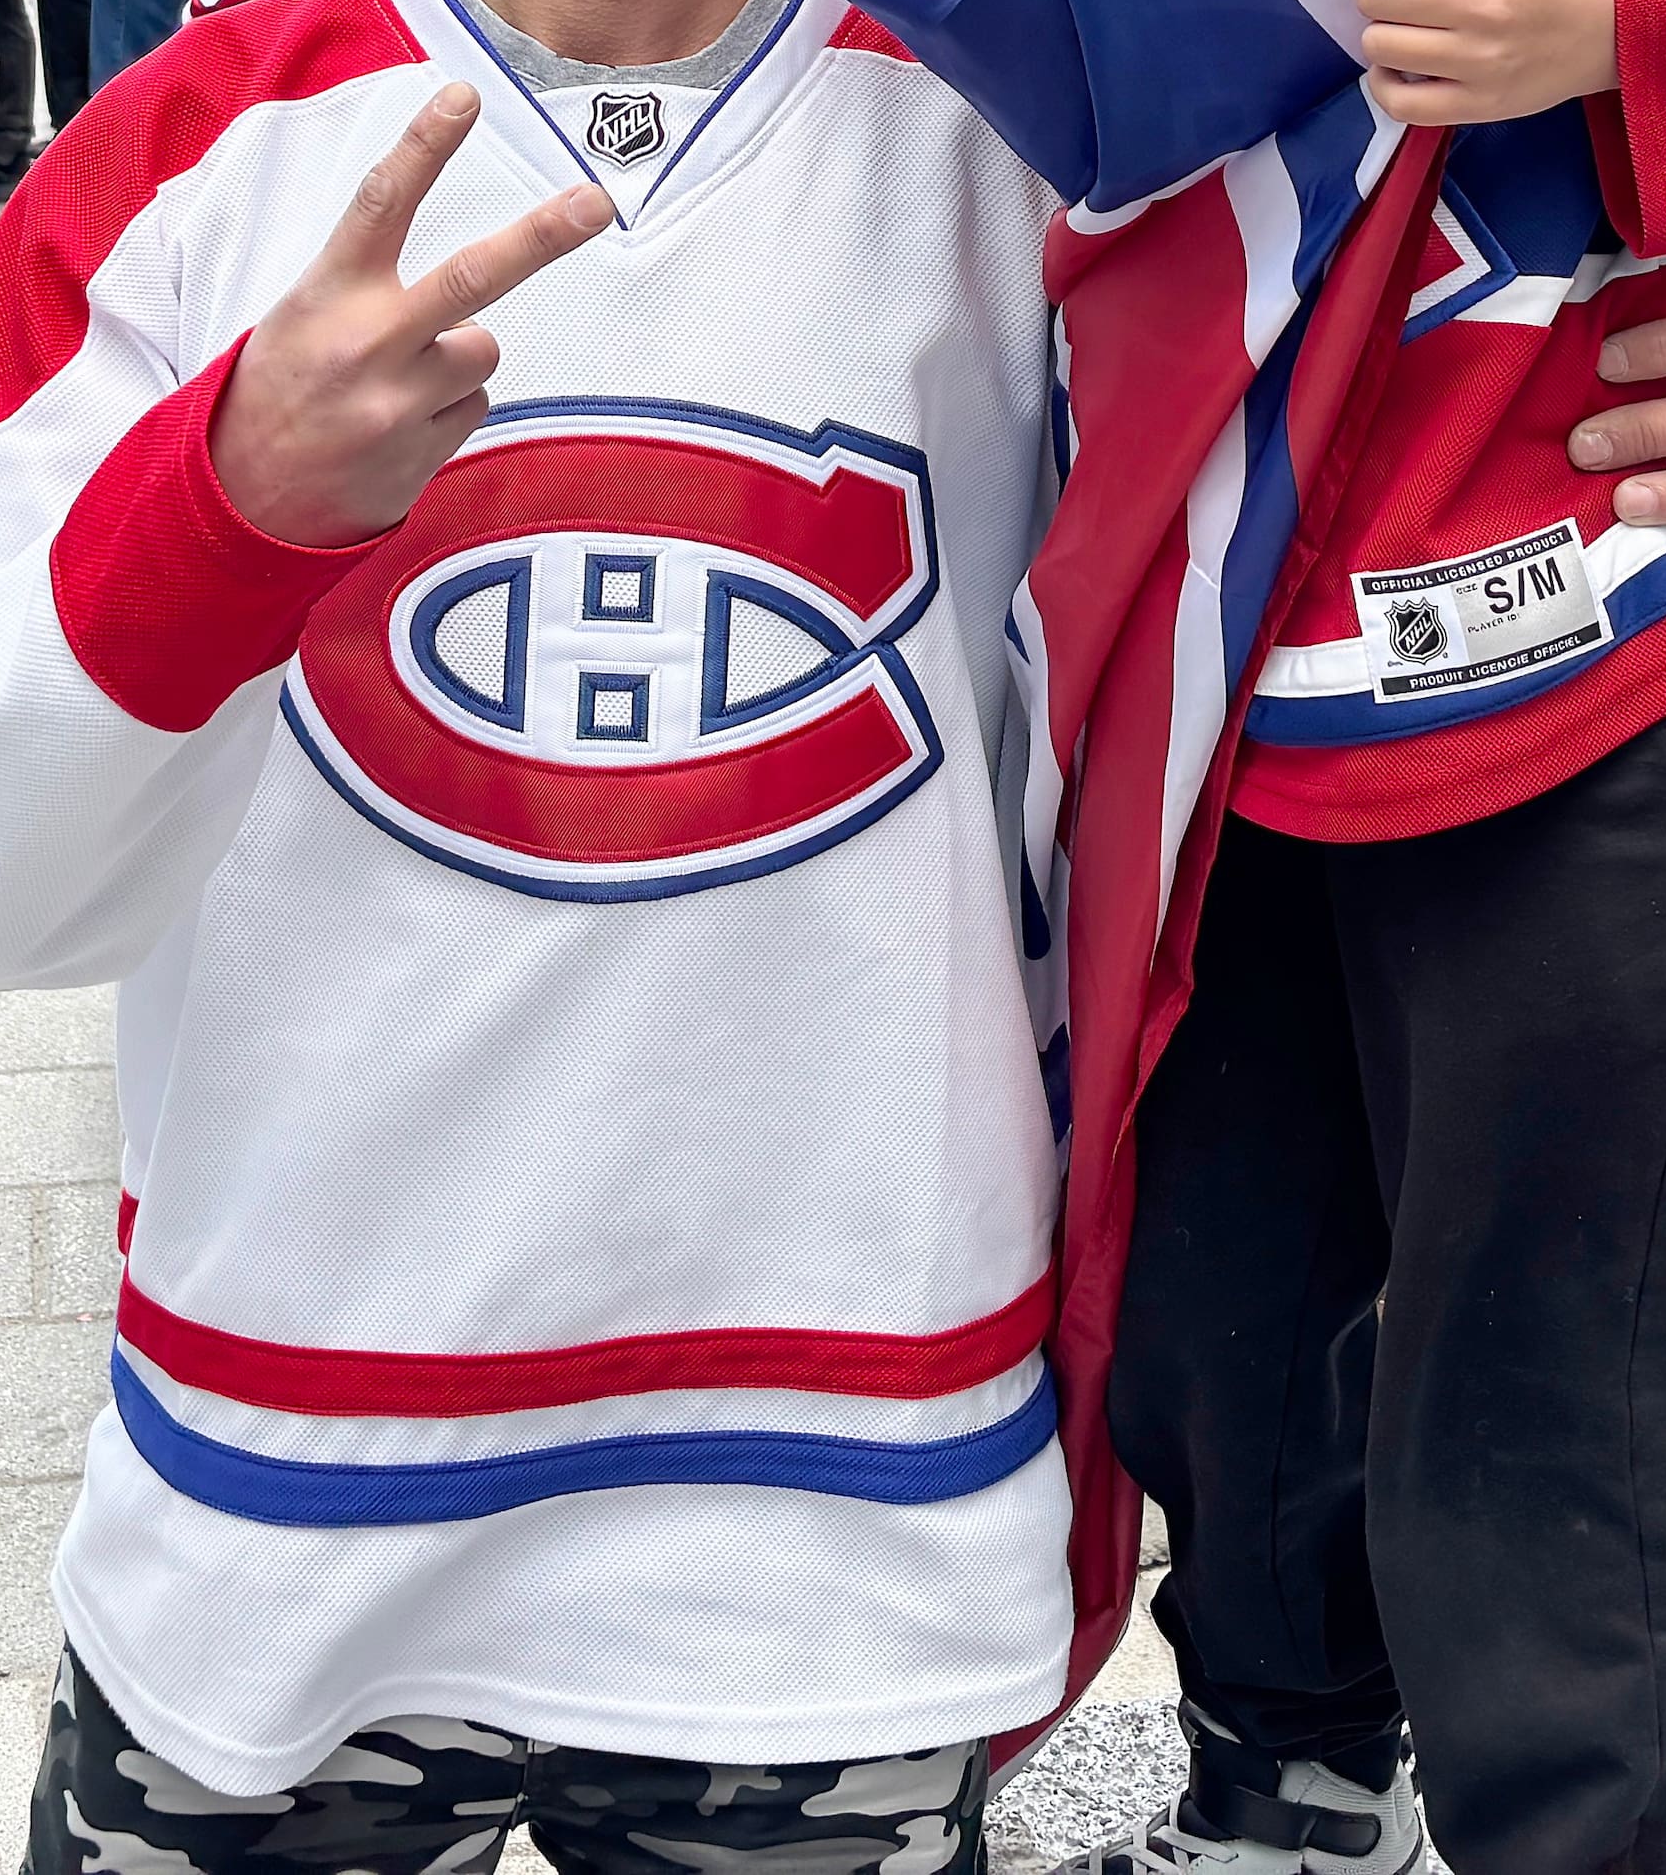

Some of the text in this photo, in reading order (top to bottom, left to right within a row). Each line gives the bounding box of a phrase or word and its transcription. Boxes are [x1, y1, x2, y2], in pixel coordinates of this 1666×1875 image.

[603, 104, 651, 148] NHL
[1372, 531, 1565, 592] OFFICIAL LICENSED PRODUCT
[1484, 557, 1566, 615] S/M
[1404, 615, 1433, 651] NHL
[1410, 672, 1464, 689] PRODUIT
[1534, 636, 1581, 659] OFFICIEL
